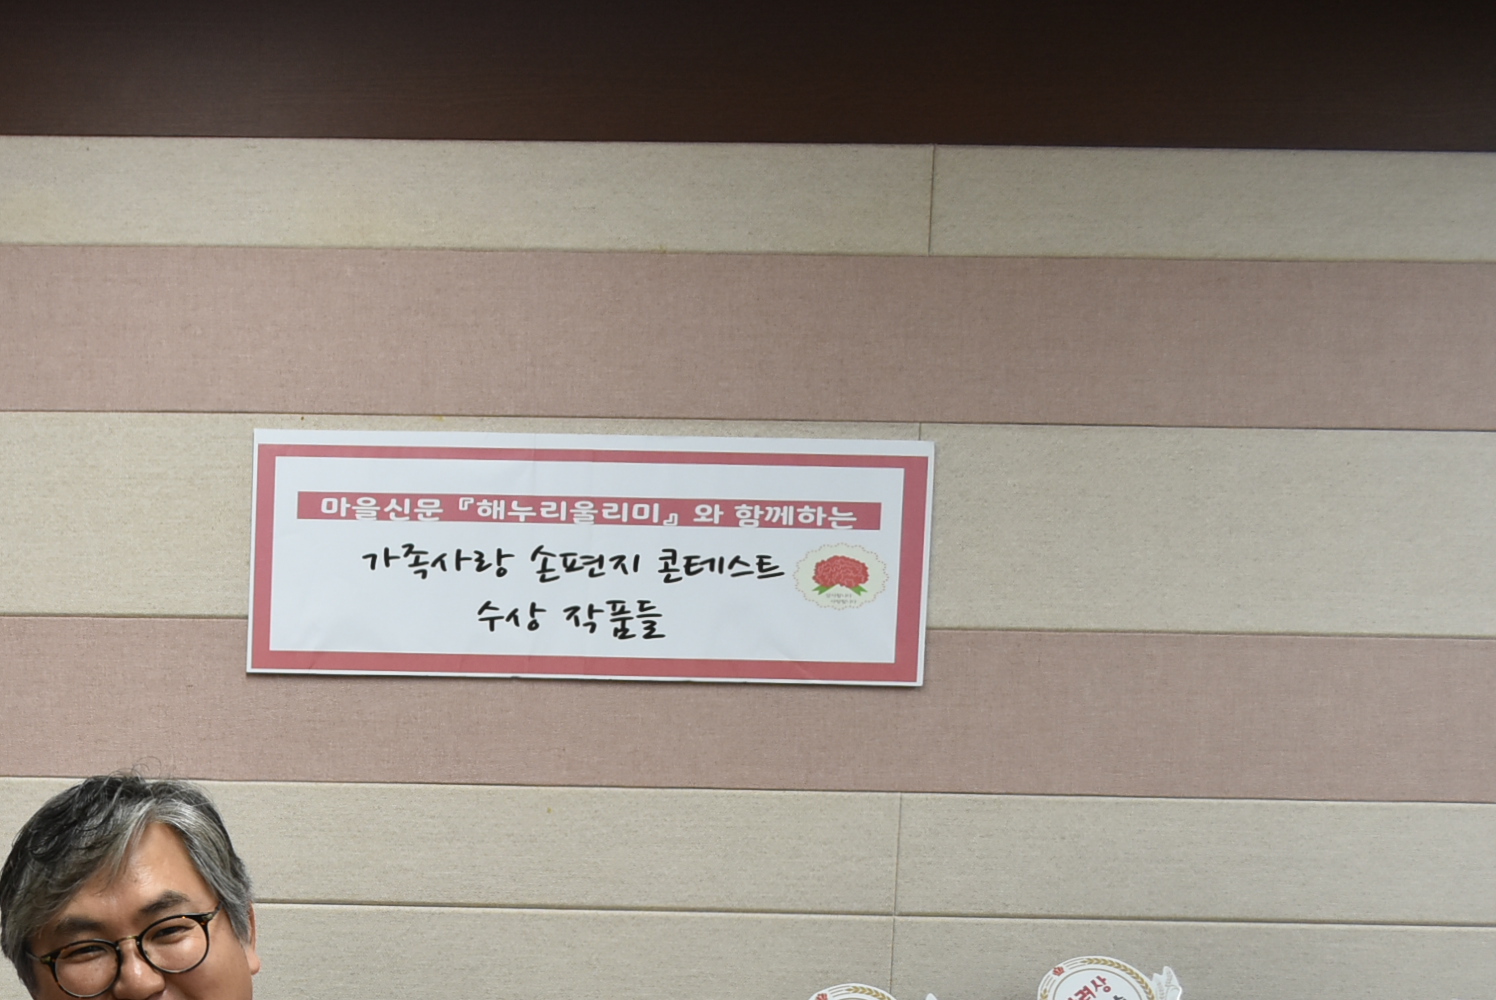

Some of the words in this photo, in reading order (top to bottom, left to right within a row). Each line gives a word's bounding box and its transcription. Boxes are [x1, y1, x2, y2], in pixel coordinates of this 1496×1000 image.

[320, 496, 444, 521] 마을신문
[693, 503, 724, 525] 와
[734, 503, 857, 529] 함께하는
[363, 543, 515, 579] 가족사랑
[530, 544, 641, 583] 손편지
[658, 548, 785, 584] 콘테스트
[477, 600, 547, 632] 수상
[563, 599, 666, 640] 작품들
